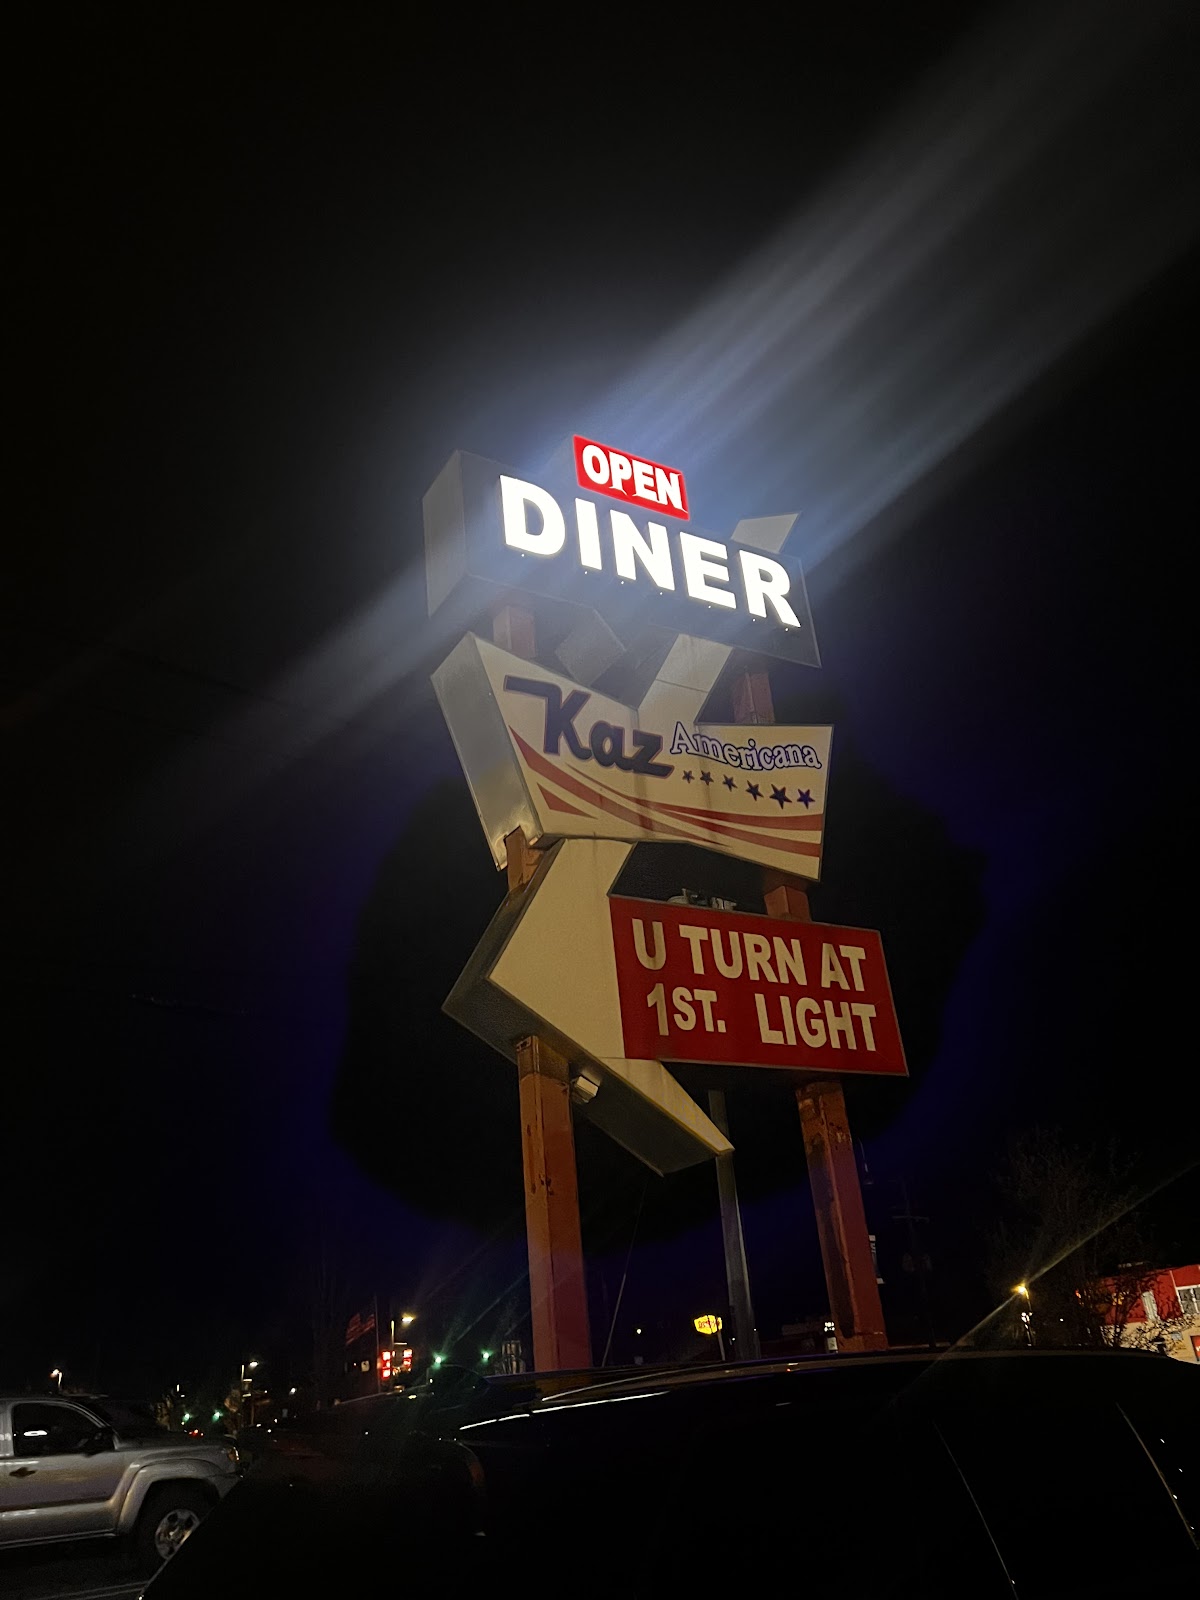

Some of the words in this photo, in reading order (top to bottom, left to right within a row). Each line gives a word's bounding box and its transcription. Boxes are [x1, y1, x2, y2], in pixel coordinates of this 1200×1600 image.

[582, 445, 685, 510] OPEN
[499, 475, 801, 628] DINER
[504, 676, 674, 777] Kaz
[670, 721, 822, 770] Americana
[632, 918, 667, 970] U
[679, 925, 807, 985] TURN
[820, 943, 866, 991] AT
[647, 983, 726, 1036] 1ST.
[755, 993, 877, 1051] LIGHT
